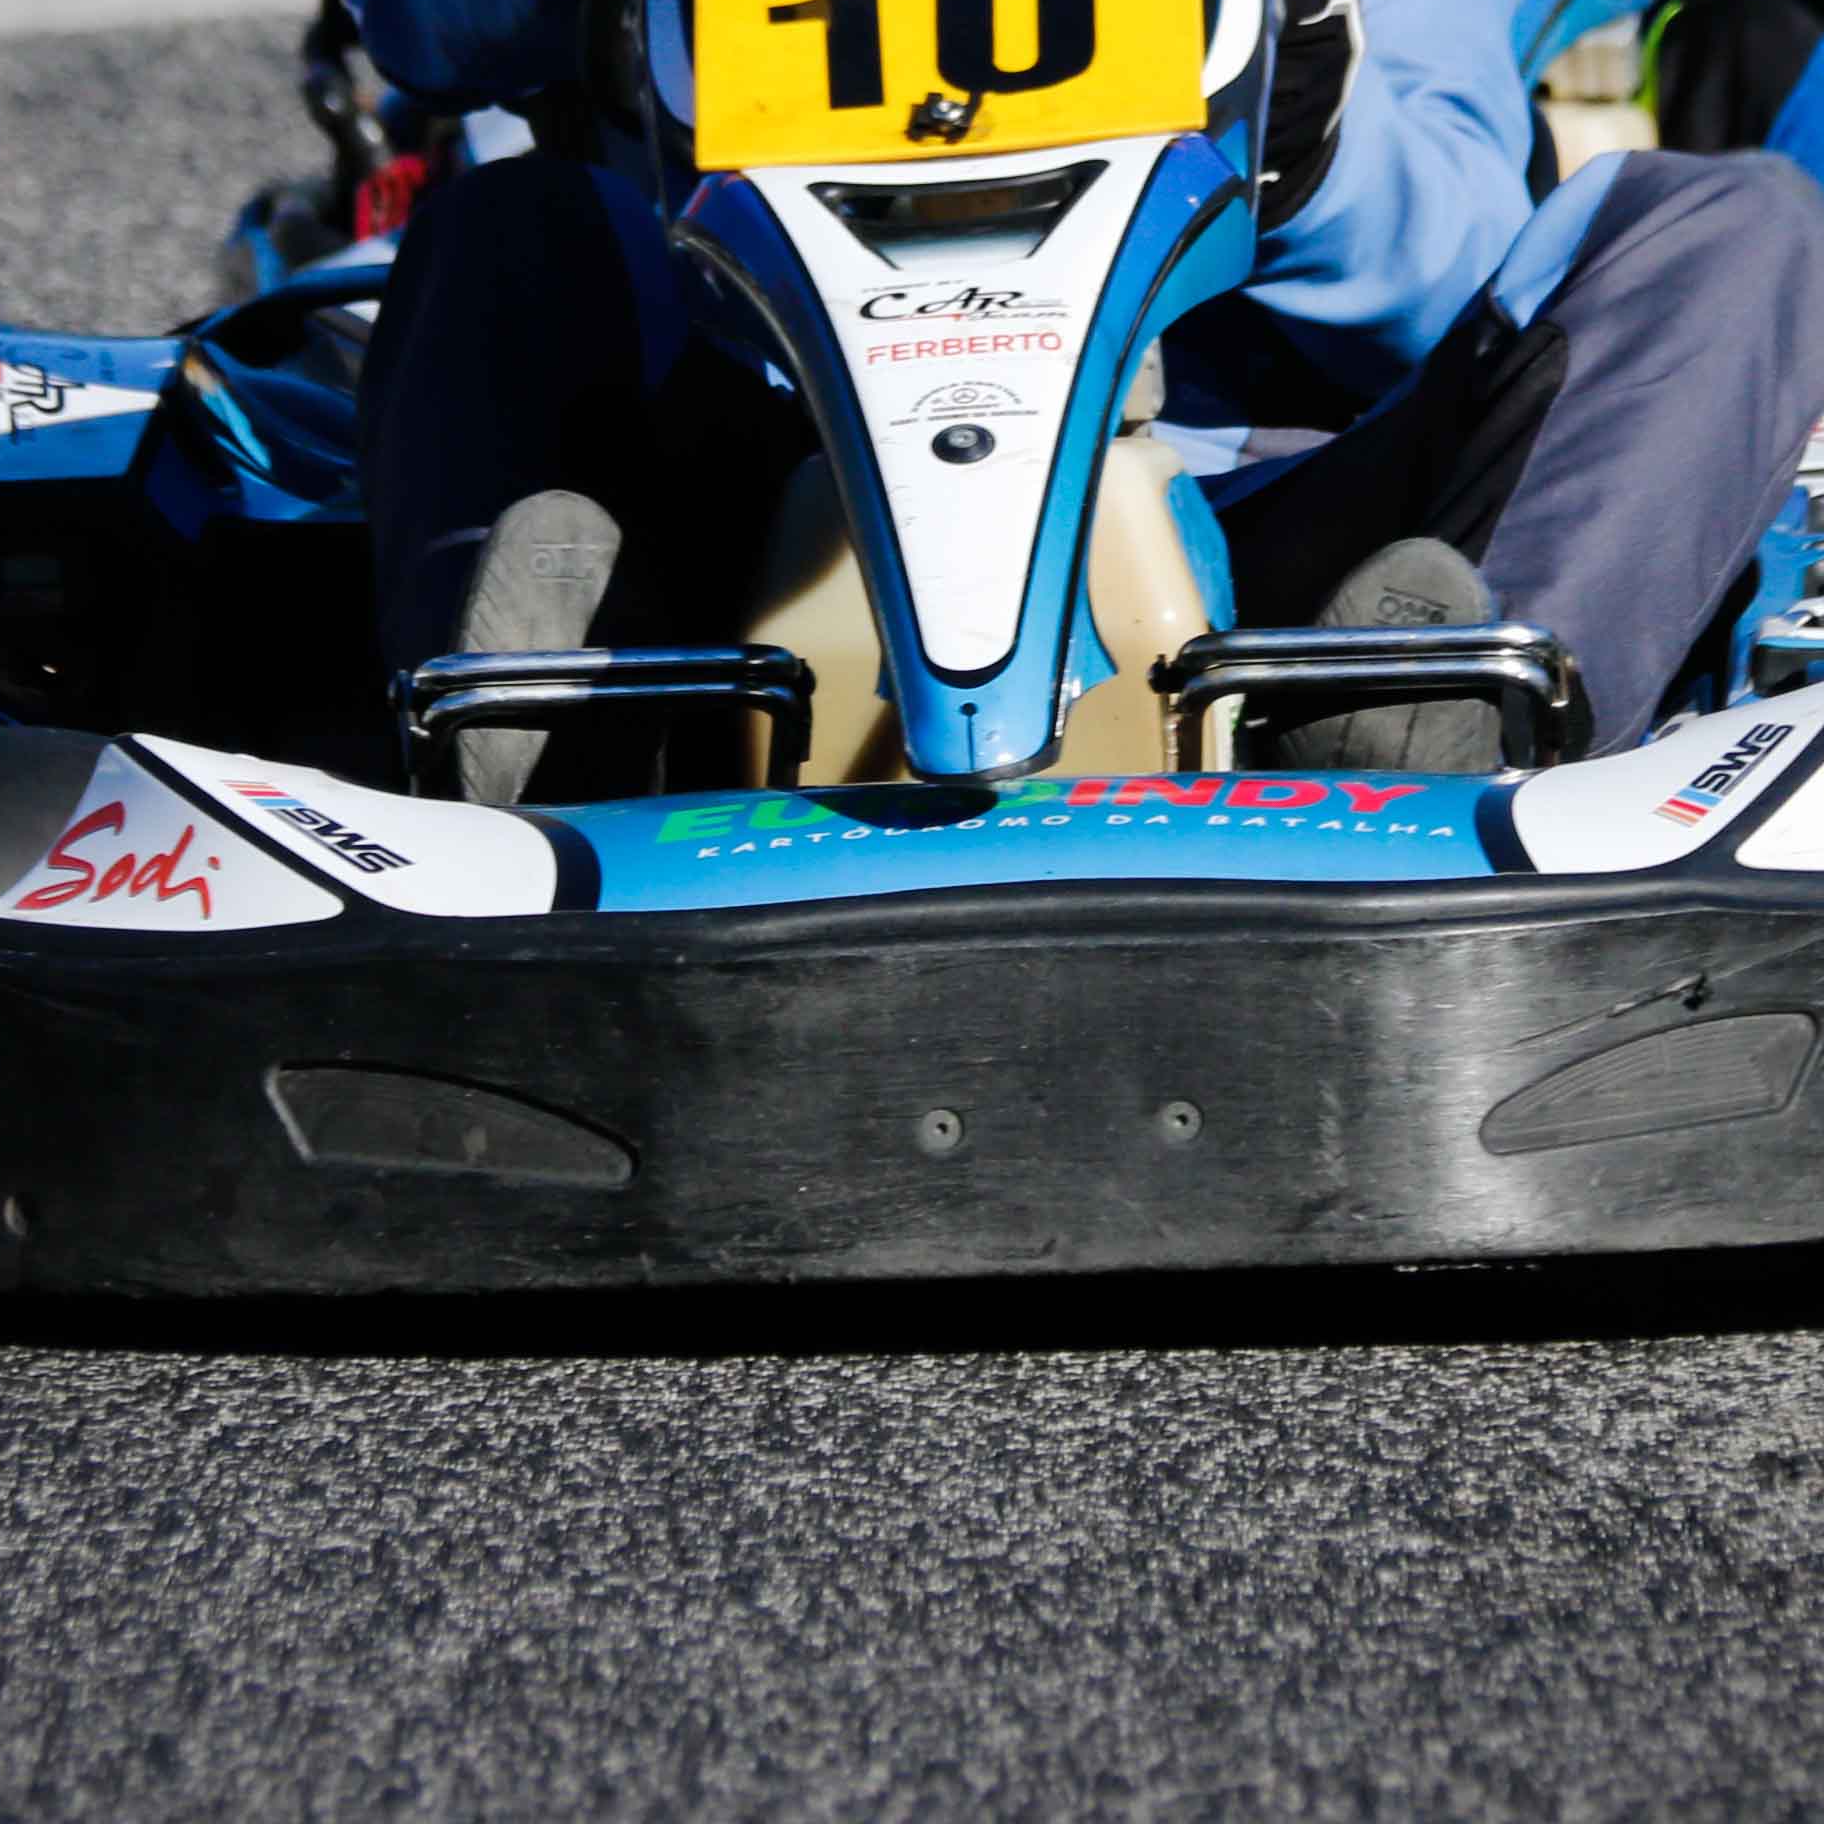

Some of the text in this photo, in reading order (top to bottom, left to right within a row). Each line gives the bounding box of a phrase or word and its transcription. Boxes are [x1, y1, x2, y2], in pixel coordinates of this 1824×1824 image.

[866, 331, 1063, 366] FERBERTO
[1105, 814, 1169, 826] DA
[1206, 814, 1456, 838] BATALHA
[15, 800, 222, 920] Sodi
